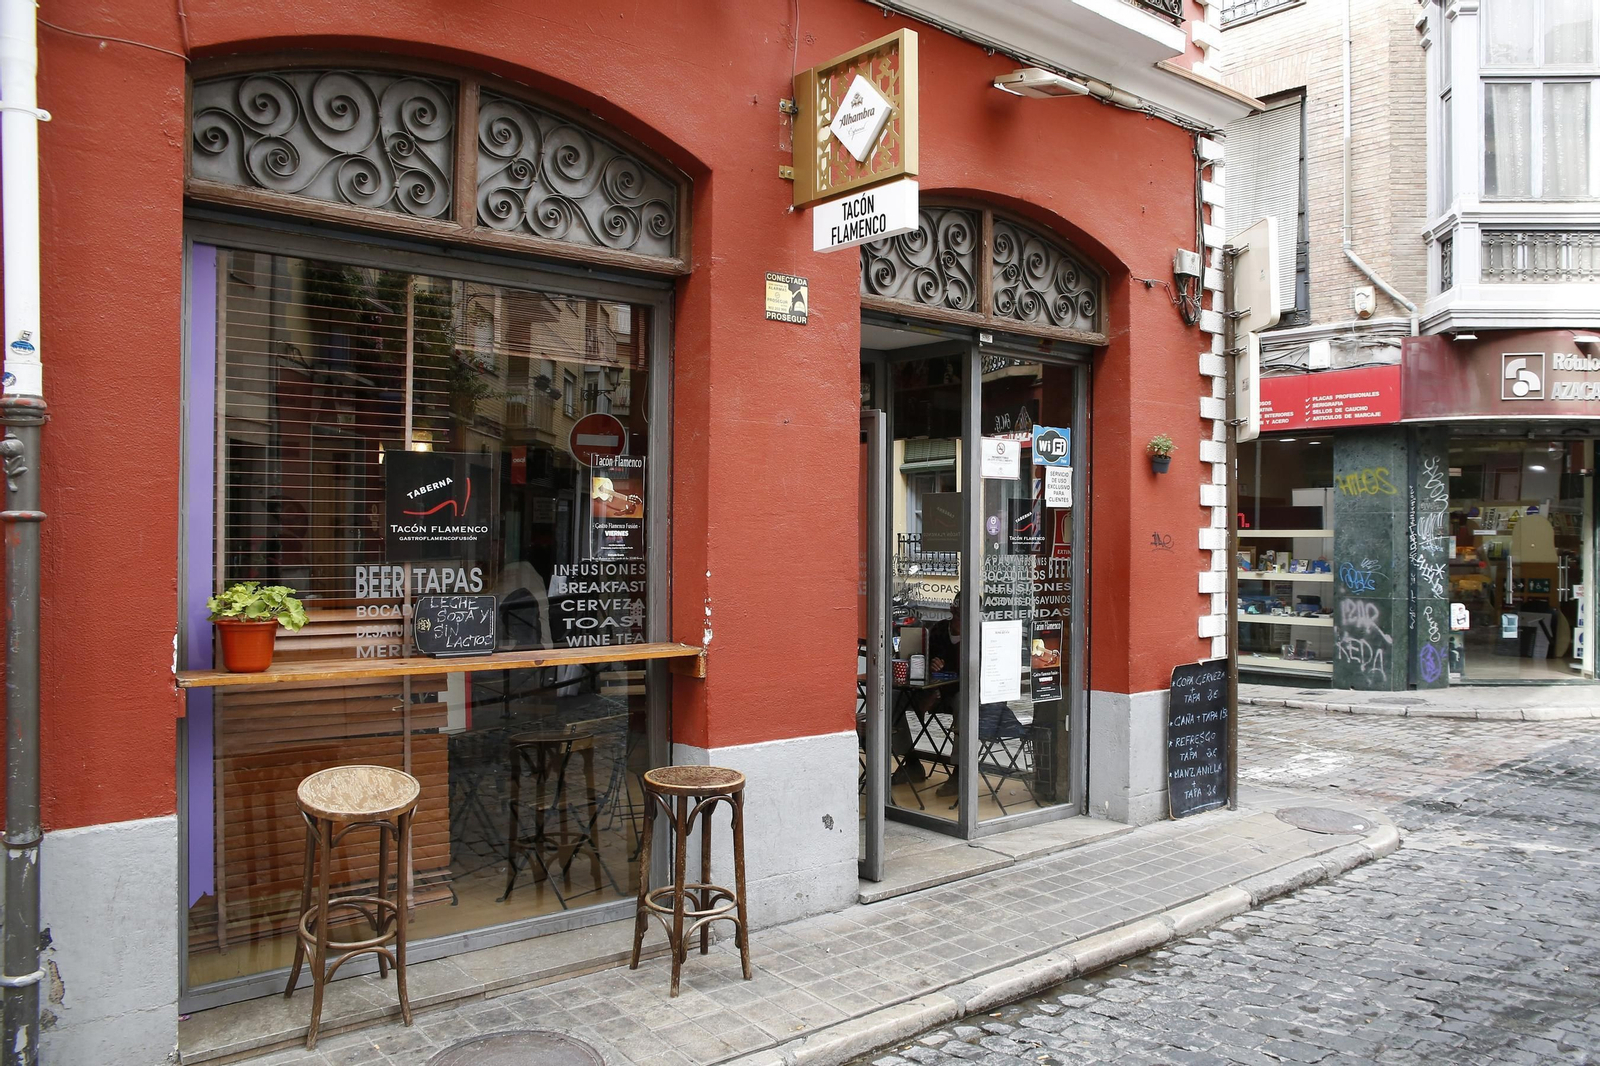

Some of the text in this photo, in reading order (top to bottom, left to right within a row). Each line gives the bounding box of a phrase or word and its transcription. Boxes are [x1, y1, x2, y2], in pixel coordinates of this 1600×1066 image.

[838, 107, 876, 130] Alhambra
[842, 192, 874, 221] TACÓN
[831, 213, 886, 246] FLAMENCO
[766, 272, 808, 286] CONECTADA
[766, 311, 807, 324] PROSEGUR
[1336, 392, 1380, 400] PROFESIONALES
[595, 454, 642, 468] Tacón Flamenco
[1050, 470, 1070, 478] SERVICIO
[406, 477, 454, 500] TABERNA
[390, 524, 426, 533] TACÓN
[554, 564, 646, 576] INFUSIONES
[982, 570, 1046, 580] BOCADILLOS
[356, 566, 484, 598] BEER TAPAS
[558, 580, 646, 594] BREAKFAST
[922, 584, 960, 594] COPAS
[430, 596, 480, 610] LECHE
[560, 598, 646, 612] CERVEZA
[436, 610, 475, 623] SOJA
[480, 609, 490, 624] Y
[980, 608, 1071, 620] MERIENDAS
[562, 616, 646, 630] TOAST
[566, 632, 646, 648] WINE TEA
[1176, 670, 1226, 688] COPA CERVEZA
[1184, 692, 1200, 704] TAPA
[1174, 712, 1194, 726] CAÑA
[1202, 710, 1218, 723] TAPA
[1180, 751, 1198, 762] TAPA
[1174, 763, 1222, 778] MANZANILLA
[1184, 788, 1202, 800] TAPA
